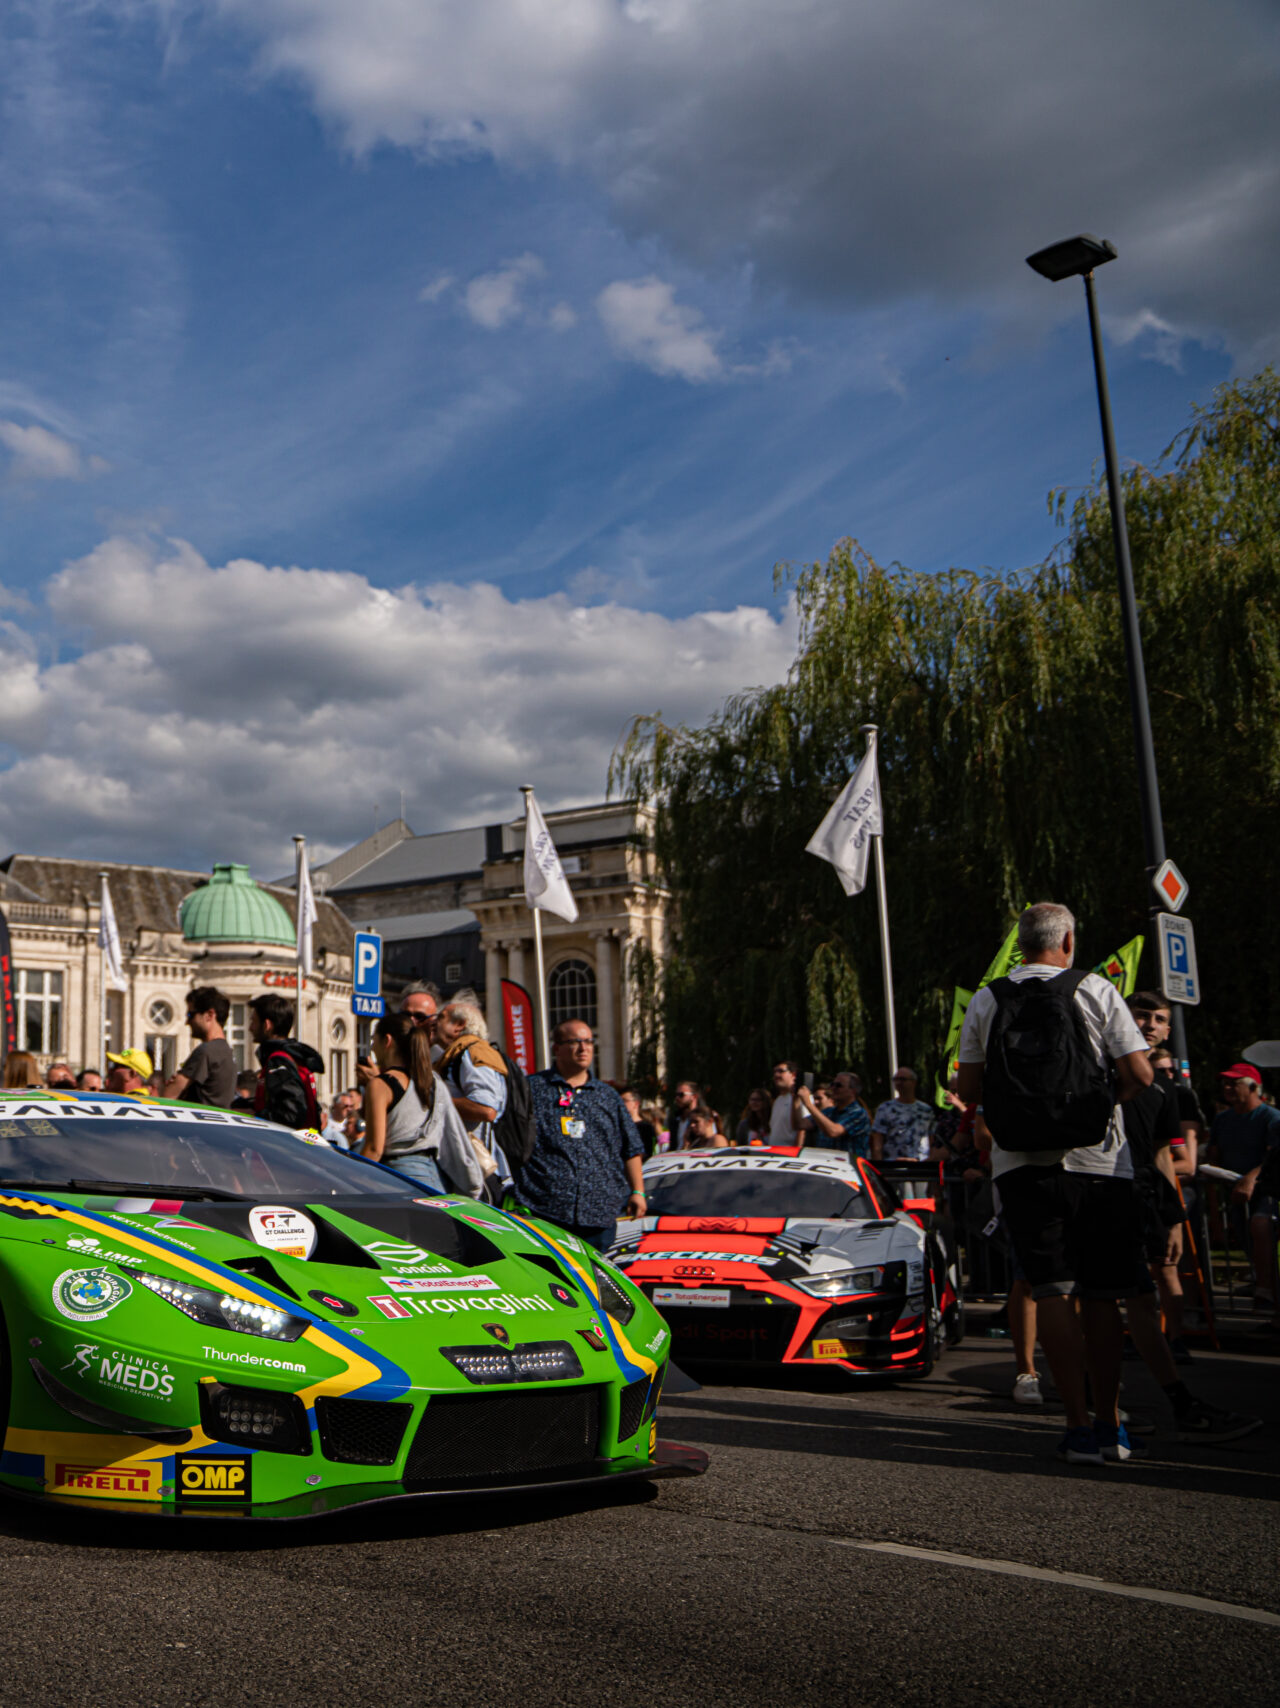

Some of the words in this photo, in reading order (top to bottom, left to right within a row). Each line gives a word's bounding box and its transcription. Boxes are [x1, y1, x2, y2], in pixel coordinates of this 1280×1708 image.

[1164, 919, 1186, 932] ZONE
[357, 942, 377, 985] P
[355, 998, 382, 1014] TAXI
[642, 1159, 840, 1175] FANATEC
[109, 1213, 143, 1228] NEXTY
[143, 1226, 197, 1251] Electronics
[80, 1245, 142, 1264] OLIMP
[612, 1250, 782, 1267] SKECHERS
[392, 1262, 453, 1274] soncini
[90, 1271, 120, 1303] CASIRAGHI
[414, 1278, 493, 1288] TotalEnergies
[399, 1293, 555, 1315] Travaglini
[674, 1293, 728, 1302] TotalEnergies
[704, 1321, 768, 1343] Sport
[111, 1351, 170, 1373] CLINICA
[201, 1346, 307, 1374] Thundercomm
[99, 1358, 175, 1396] MEDS
[98, 1379, 128, 1392] MEDICINA
[130, 1388, 165, 1401] DEPORTIVA
[55, 1463, 151, 1492] PIRELLI
[181, 1465, 245, 1489] OMP
